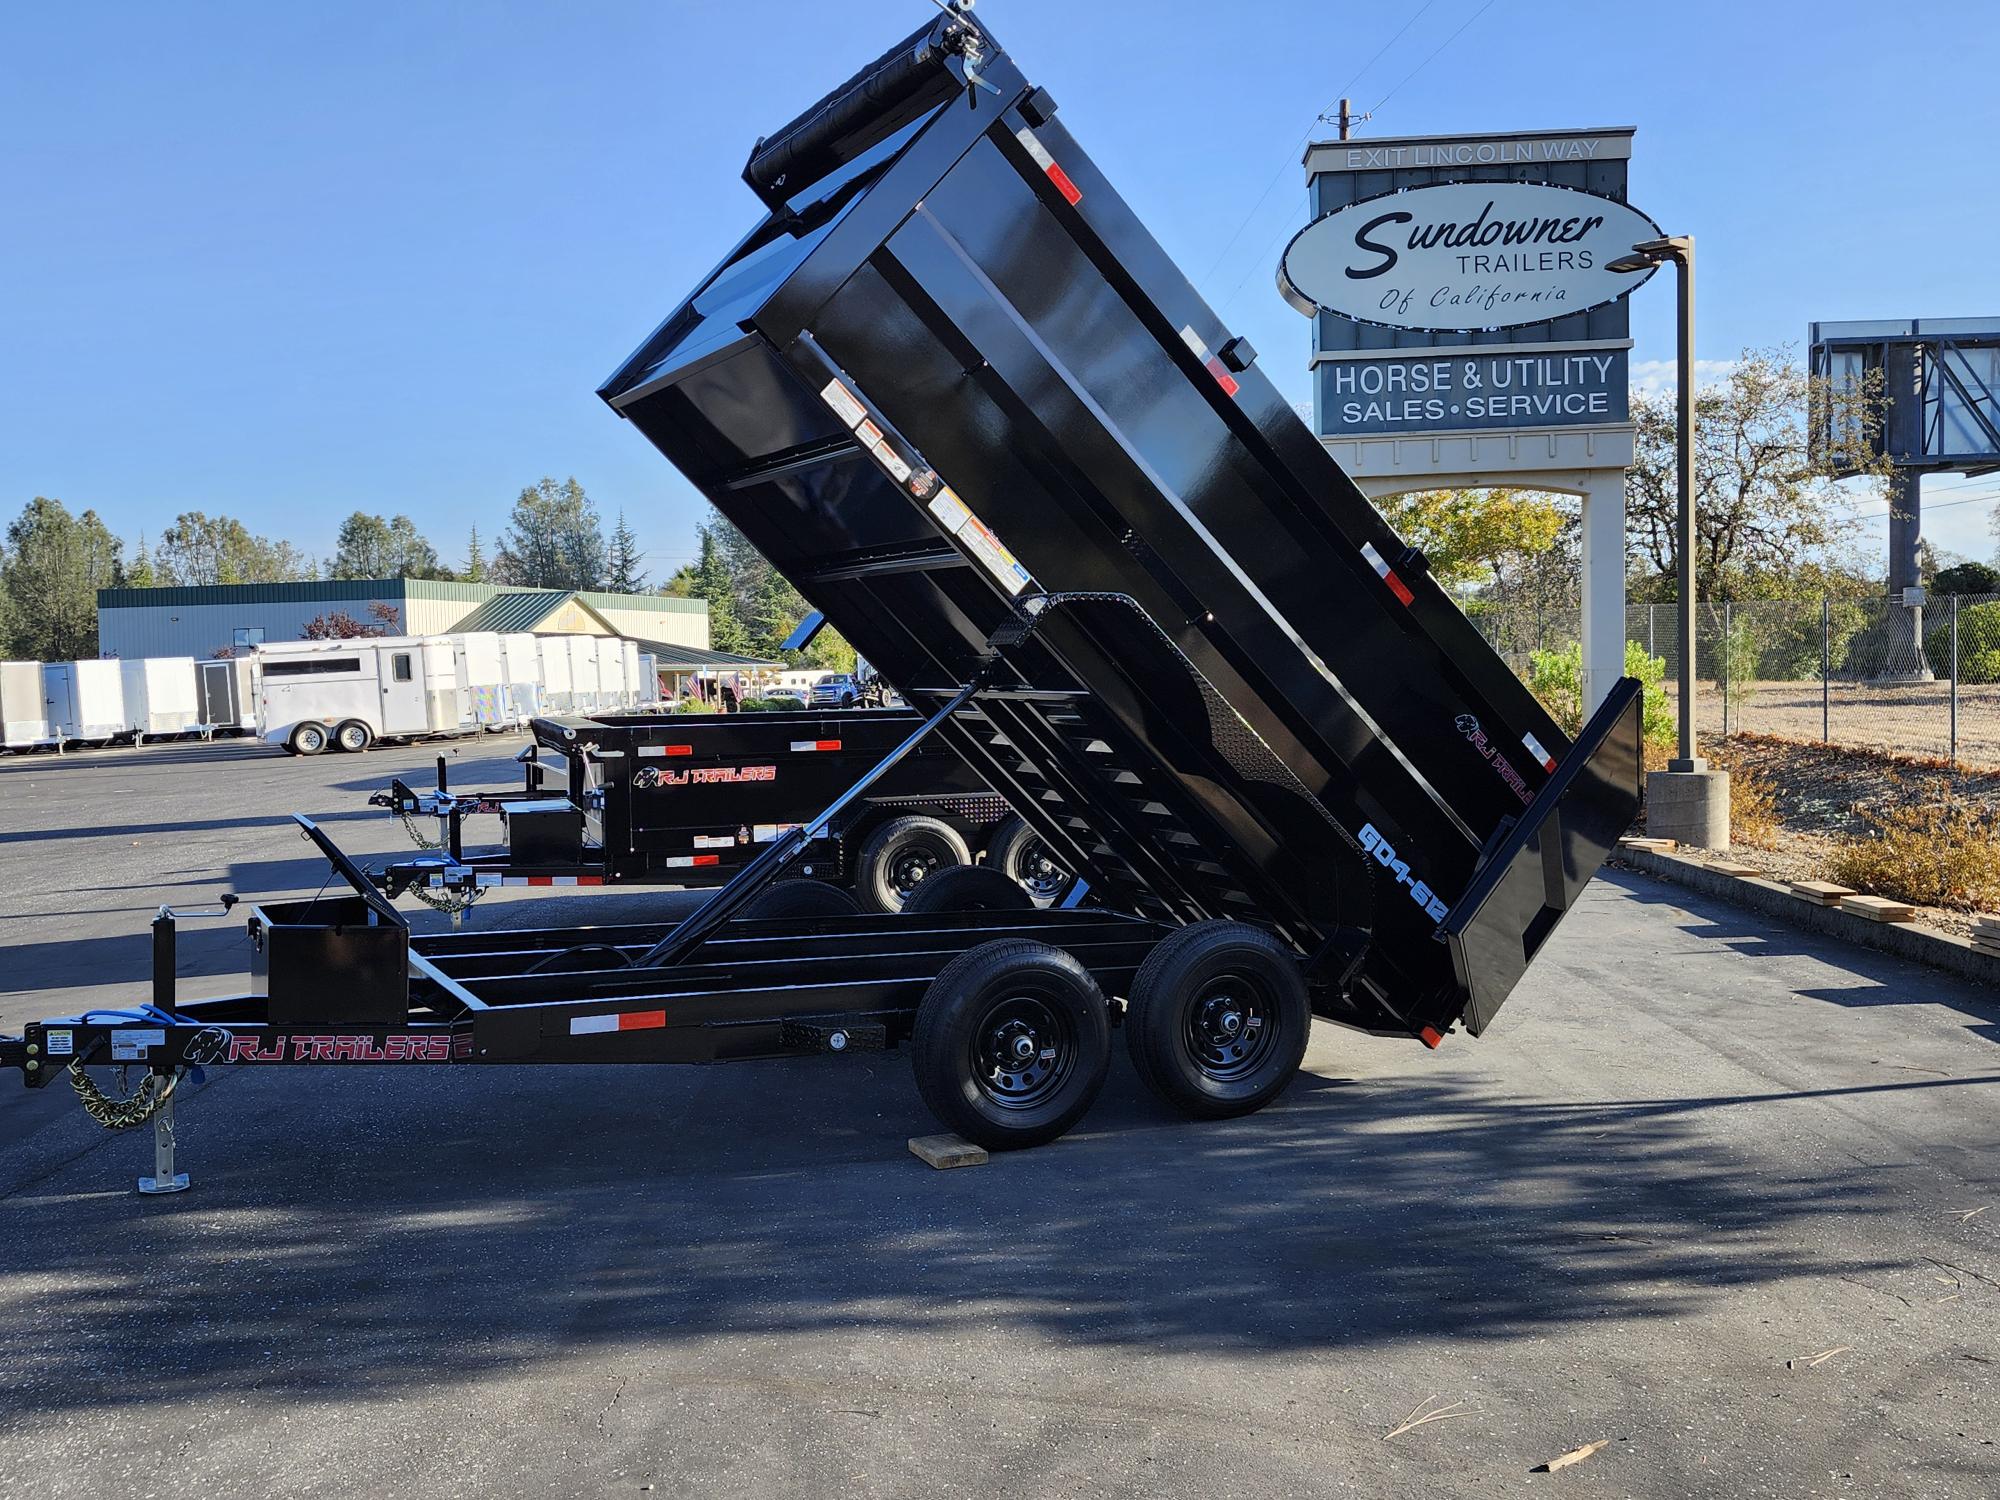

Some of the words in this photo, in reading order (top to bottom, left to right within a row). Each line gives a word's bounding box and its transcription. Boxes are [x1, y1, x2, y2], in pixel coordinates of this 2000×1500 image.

[1347, 148, 1406, 168] EXIT
[1414, 144, 1534, 166] LINCOLN
[1542, 140, 1601, 160] WAY
[1345, 201, 1603, 280] Sundowner
[1457, 251, 1593, 275] TRAILERS
[1379, 288, 1413, 315] Of
[1430, 285, 1566, 311] California
[1336, 362, 1452, 394] HORSE
[1463, 361, 1483, 389] &
[1490, 355, 1614, 388] UTILITY
[1472, 729, 1497, 759] RJ
[657, 770, 690, 786] RJ
[692, 766, 777, 784] TRAILERS
[228, 1035, 285, 1060] RJ
[291, 1035, 450, 1060] TRAILERS
